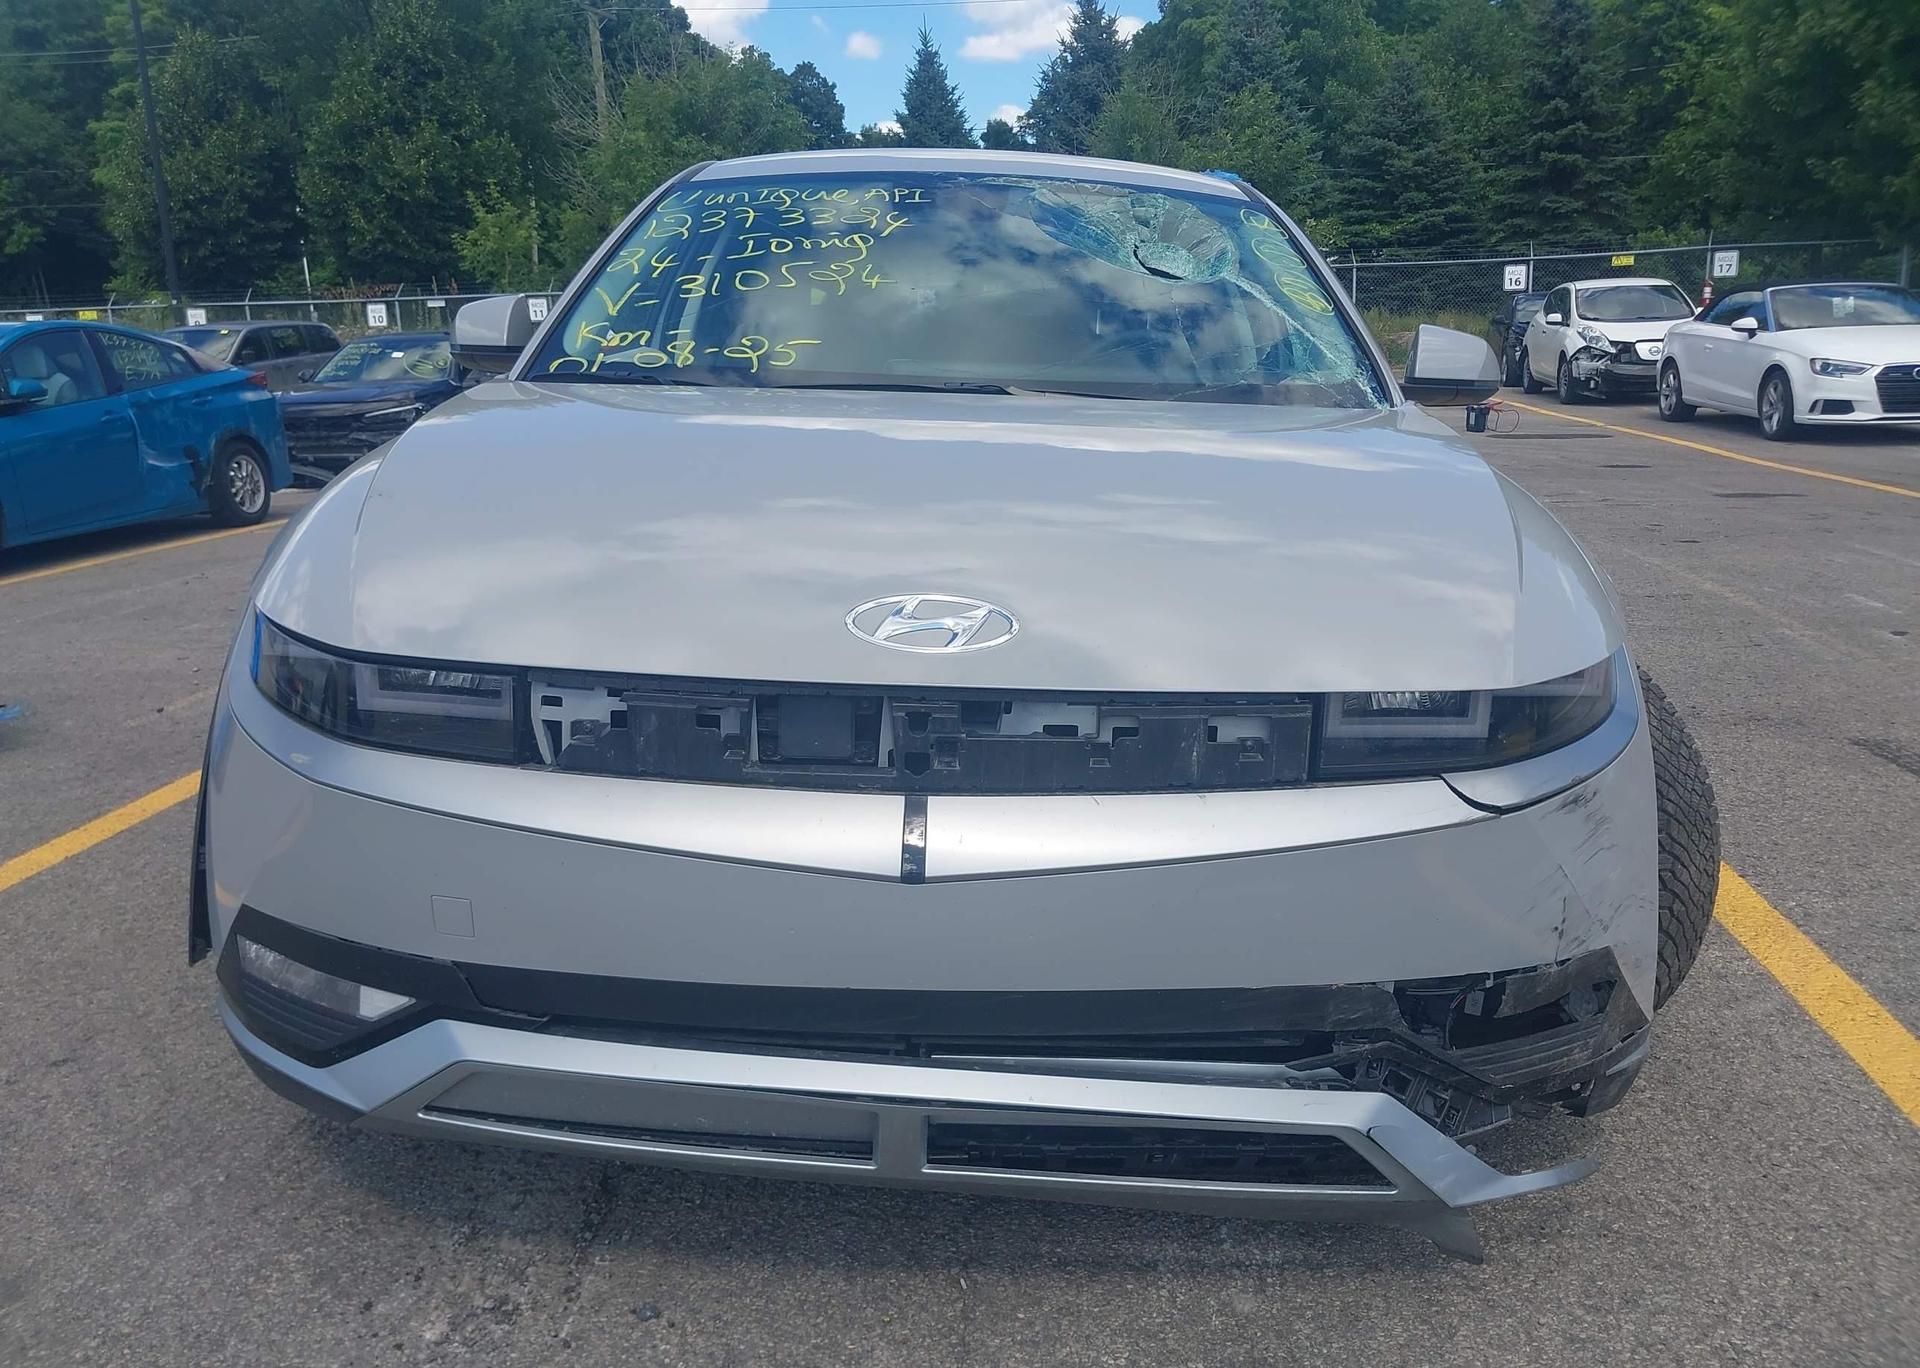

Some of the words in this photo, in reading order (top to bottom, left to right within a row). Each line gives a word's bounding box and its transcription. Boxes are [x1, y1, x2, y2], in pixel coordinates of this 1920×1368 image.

[864, 188, 932, 203] API
[1719, 264, 1732, 273] 17
[1508, 277, 1521, 286] 16
[533, 310, 544, 318] 11
[372, 315, 384, 324] 10
